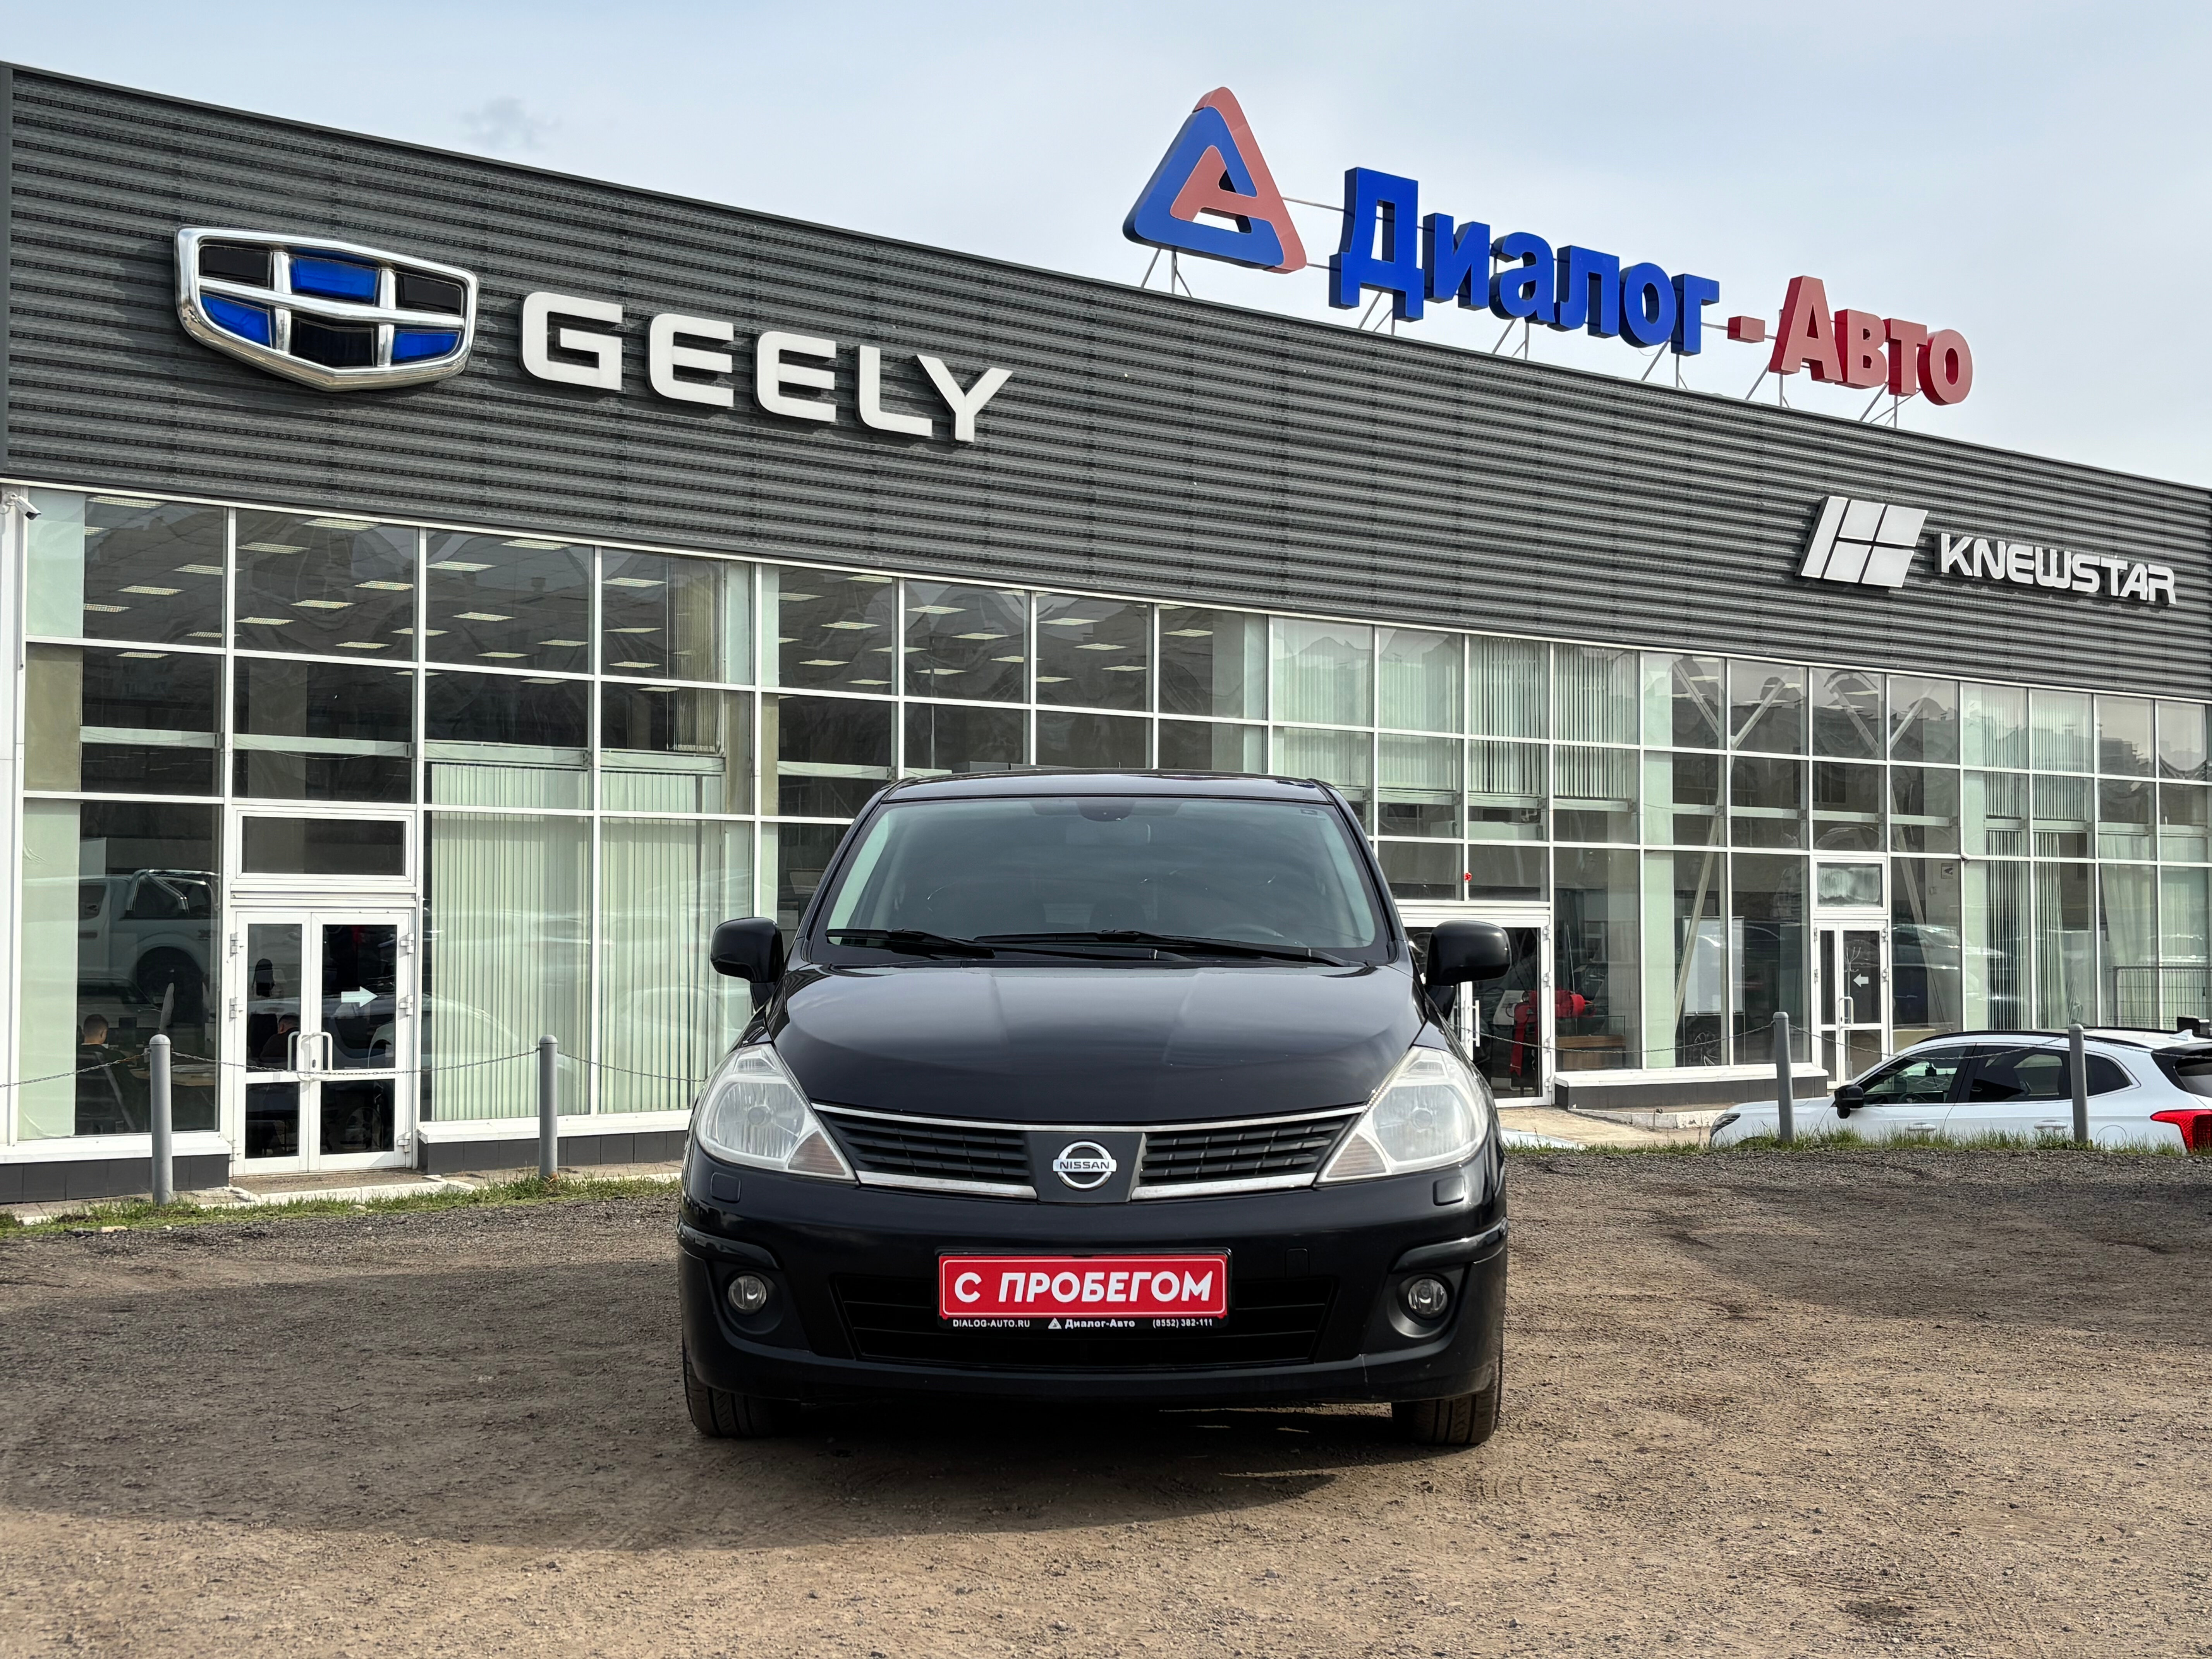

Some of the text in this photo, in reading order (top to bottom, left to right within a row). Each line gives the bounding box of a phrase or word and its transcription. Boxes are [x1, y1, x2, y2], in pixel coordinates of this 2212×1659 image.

[520, 292, 1013, 443] GEELY
[1938, 533, 2176, 604] KNEWSTAR
[954, 1271, 1213, 1303] С ПРОБЕГОМ
[953, 1319, 1030, 1328] DIALOG-AUTO.RU
[1065, 1319, 1135, 1329] Диалог-Авто
